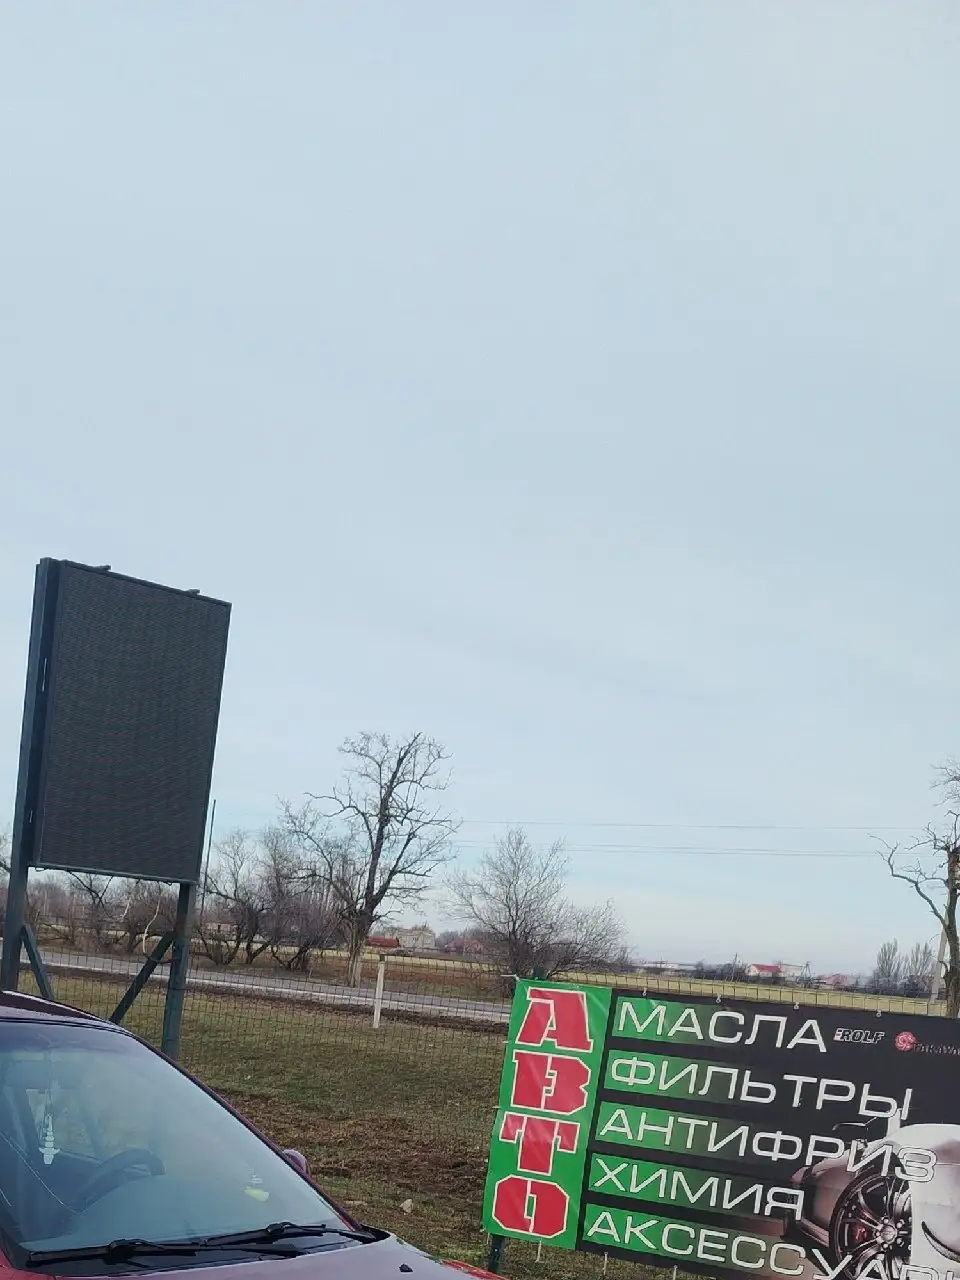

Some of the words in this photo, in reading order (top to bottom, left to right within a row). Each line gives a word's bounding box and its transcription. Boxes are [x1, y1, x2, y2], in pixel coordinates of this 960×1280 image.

[617, 1001, 827, 1053] МАСЛА
[839, 1028, 885, 1044] ROLF
[492, 987, 593, 1238] АВТО
[610, 1057, 913, 1121] ФИЛЬТРЫ
[599, 1108, 938, 1183] АНТИФРИЗ
[593, 1157, 805, 1221] ХИМИЯ
